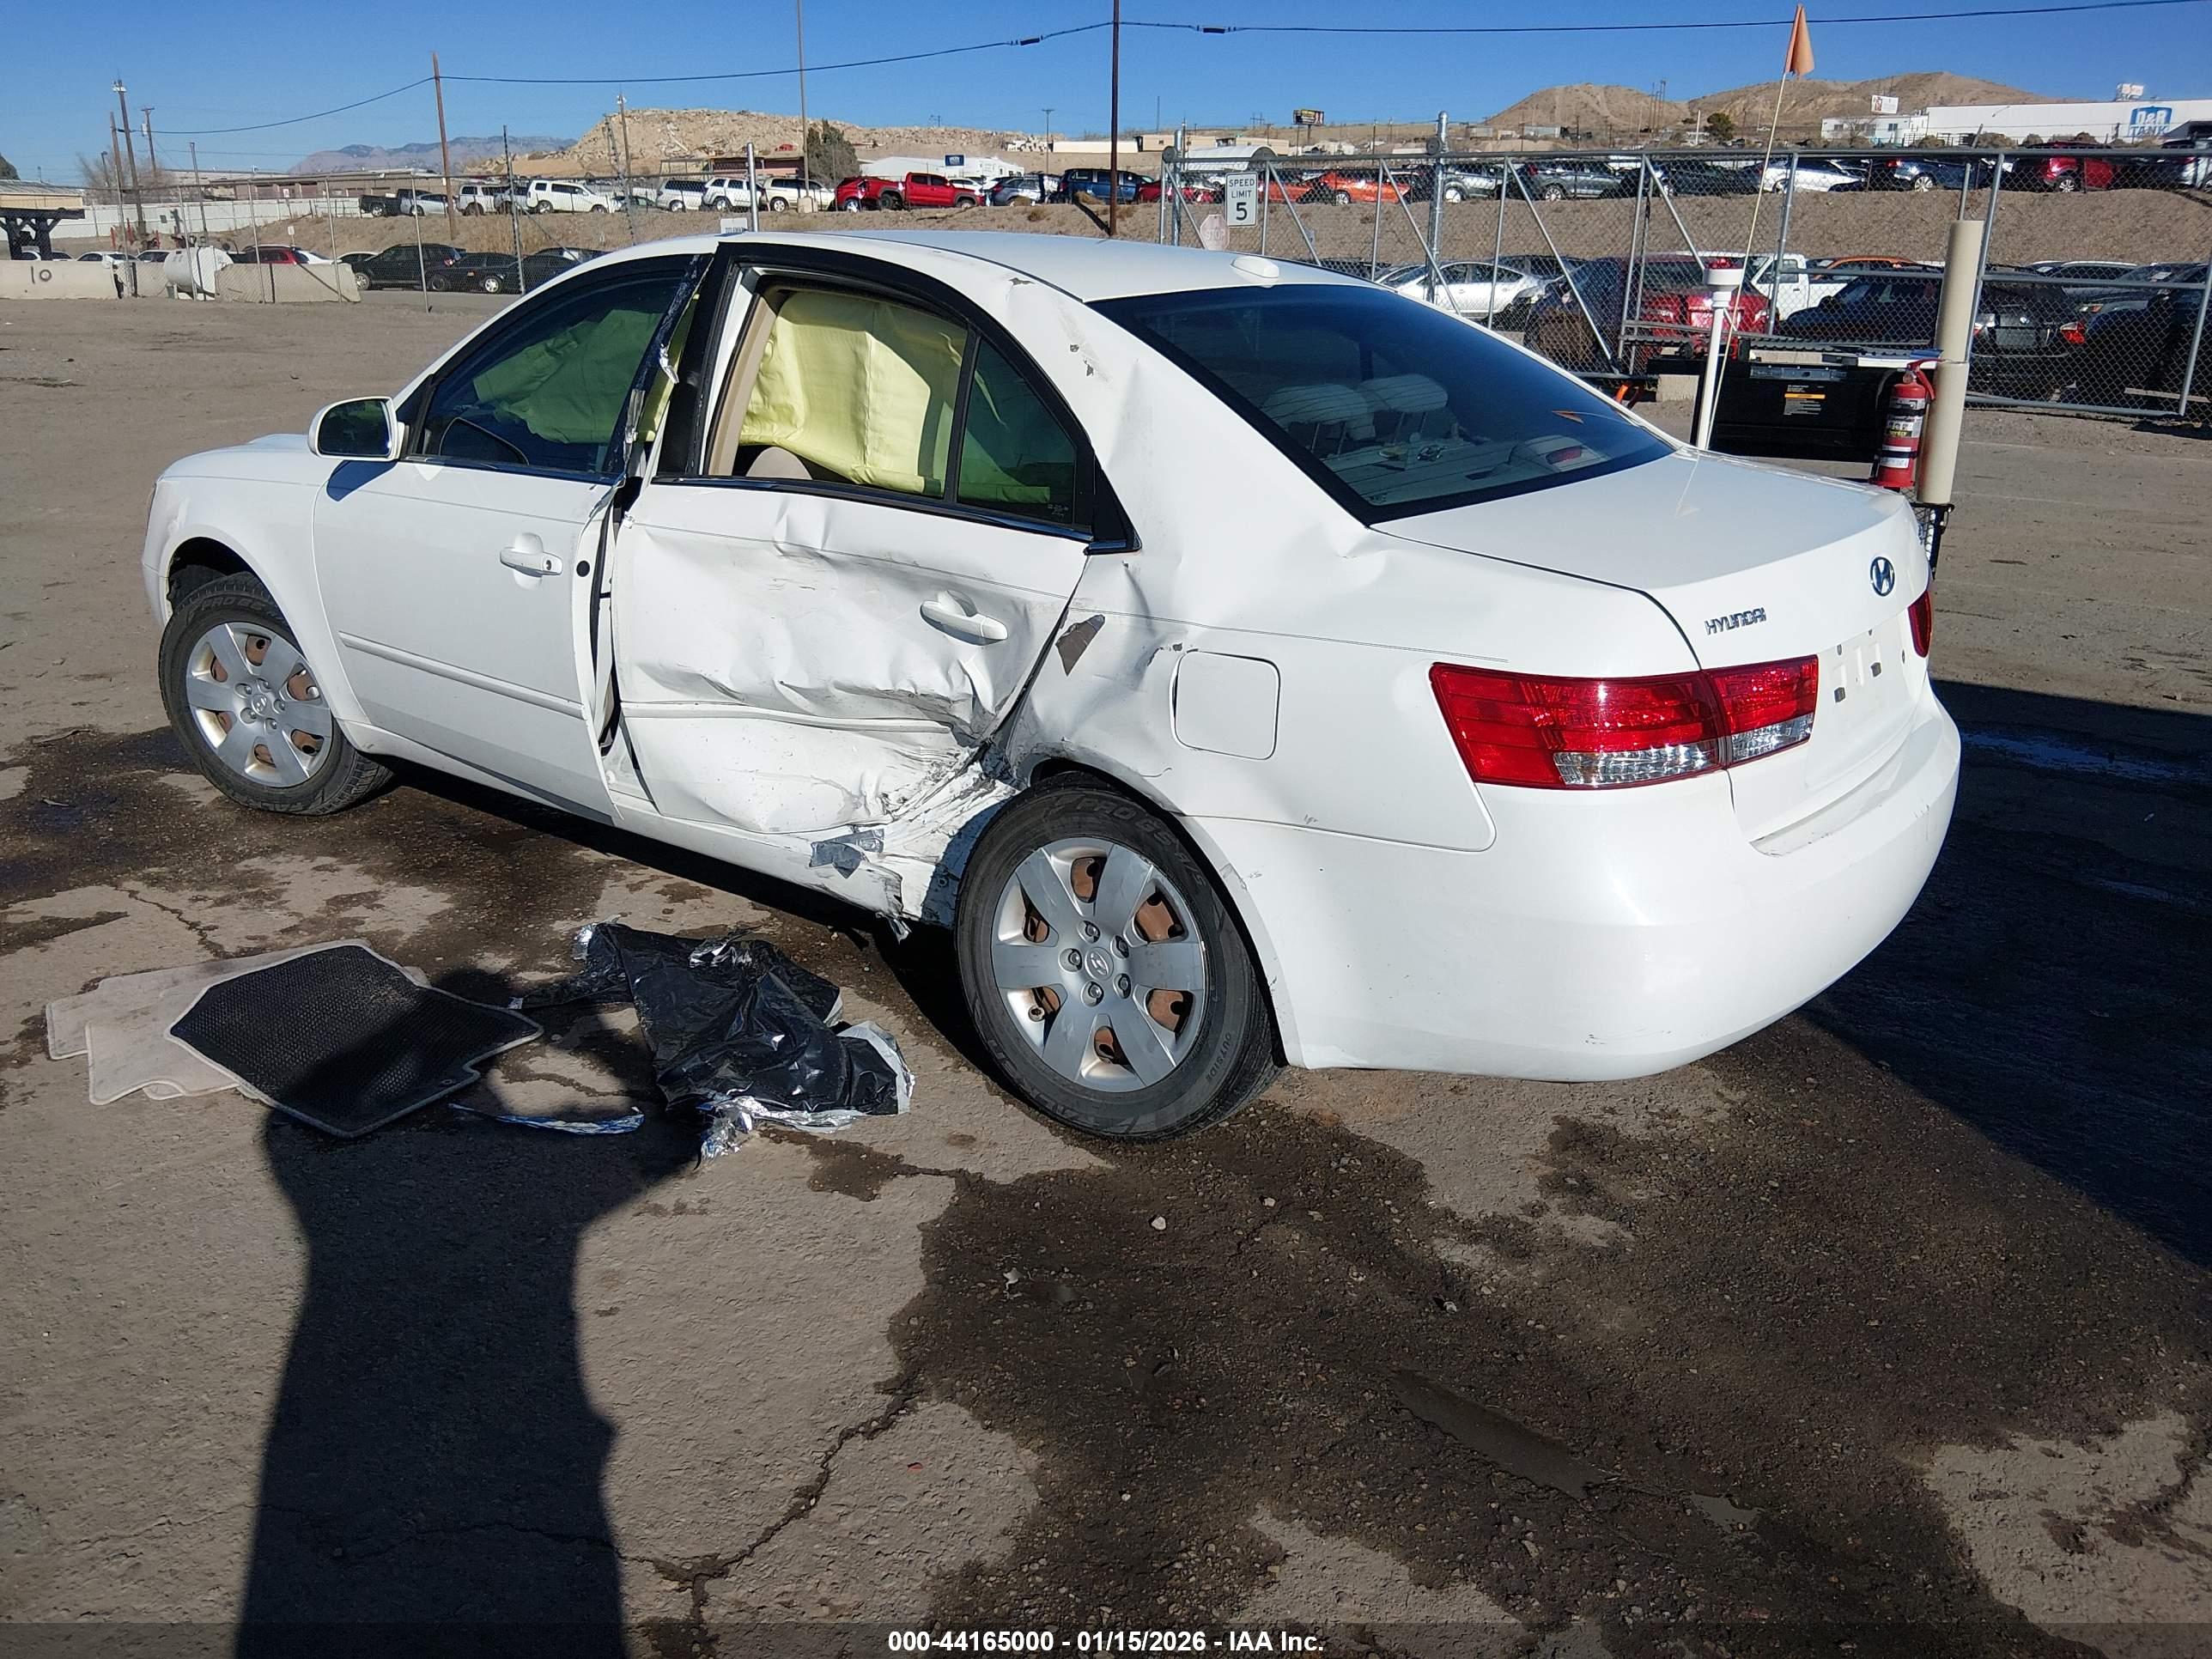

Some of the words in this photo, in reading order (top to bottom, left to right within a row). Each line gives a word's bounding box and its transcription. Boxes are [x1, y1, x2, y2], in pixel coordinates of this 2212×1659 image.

[2136, 109, 2167, 125] D&R
[2129, 124, 2170, 138] TANK
[1229, 179, 1255, 187] SPEED
[1231, 190, 1252, 198] LIMIT
[1236, 202, 1248, 221] 5
[1205, 228, 1225, 240] STOP
[31, 265, 52, 284] 10
[1705, 607, 1767, 635] HYUNDAI
[1075, 796, 1137, 822] PRO
